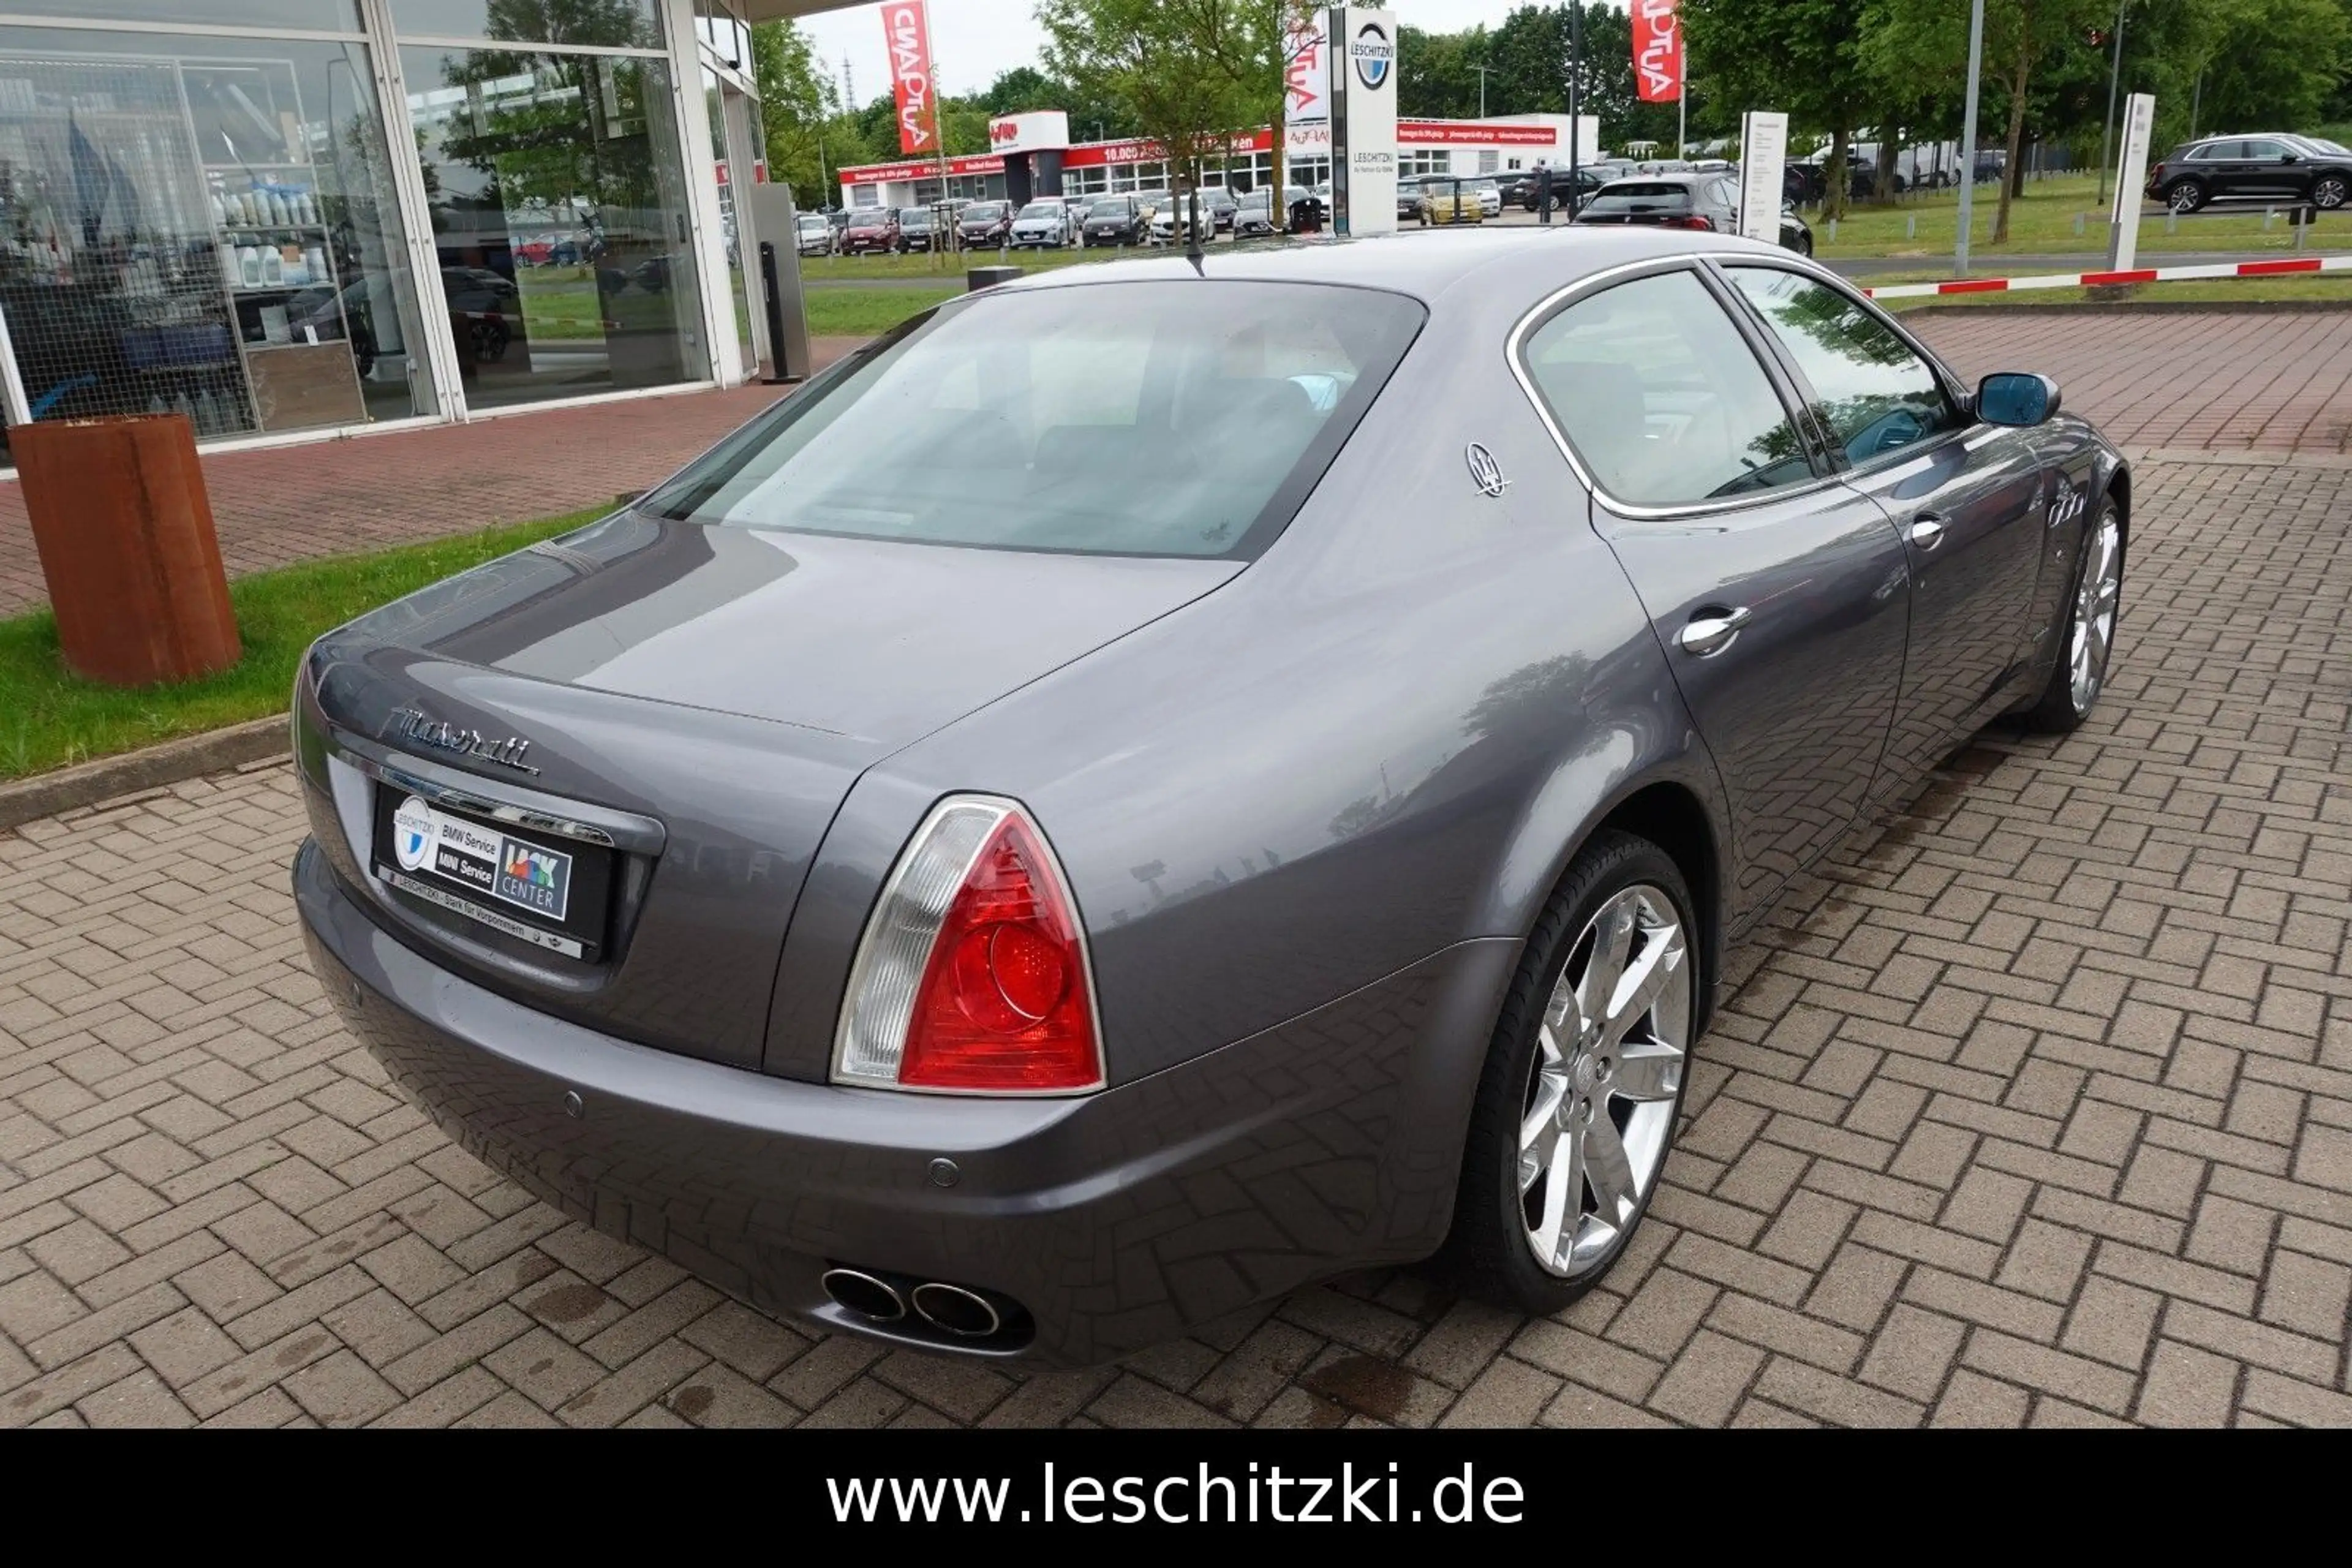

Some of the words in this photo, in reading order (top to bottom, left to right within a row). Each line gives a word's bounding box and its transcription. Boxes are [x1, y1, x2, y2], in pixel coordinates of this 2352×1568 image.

[1351, 42, 1394, 58] LESCHITZKI
[1104, 146, 1138, 162] 10.000
[377, 707, 541, 777] Maserati
[395, 813, 435, 835] LESCHITZKI
[442, 824, 465, 843] BMW
[464, 833, 496, 854] Service
[438, 852, 459, 871] MINI
[460, 860, 492, 883] Service
[502, 876, 554, 908] CENTER
[445, 894, 464, 911] Stark
[464, 901, 475, 916] für
[475, 907, 524, 936] Vorpommern
